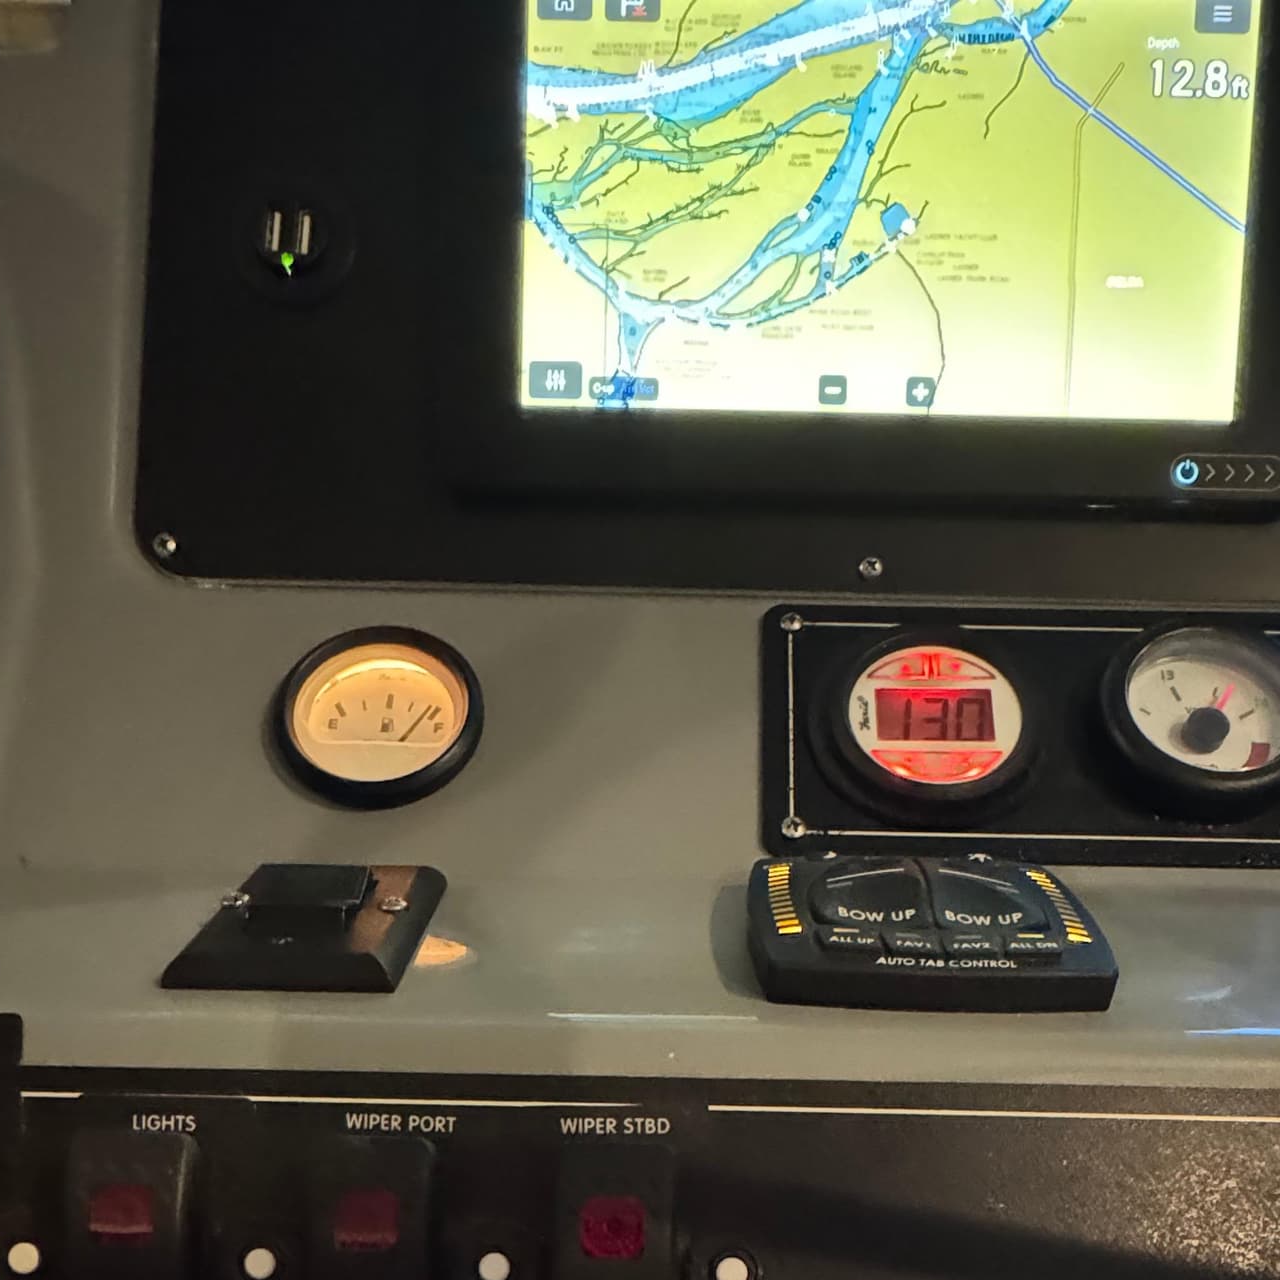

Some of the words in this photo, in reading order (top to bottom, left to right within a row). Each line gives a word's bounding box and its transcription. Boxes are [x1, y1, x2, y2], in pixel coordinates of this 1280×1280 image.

[1147, 36, 1180, 50] Depth
[1160, 669, 1175, 681] 13
[327, 718, 339, 730] E
[433, 722, 444, 733] F
[837, 905, 885, 923] BOW
[891, 908, 917, 922] UP
[944, 909, 992, 926] BOW
[998, 912, 1023, 925] UP
[829, 935, 853, 943] ALL
[876, 956, 916, 966] AUTO
[919, 958, 945, 968] TAB
[948, 959, 1018, 969] CONTROL
[132, 1114, 196, 1132] LIGHTS
[345, 1112, 401, 1130] WIPER
[408, 1115, 456, 1133] PORT
[560, 1117, 617, 1135] WIPER
[623, 1117, 670, 1135] STBD
